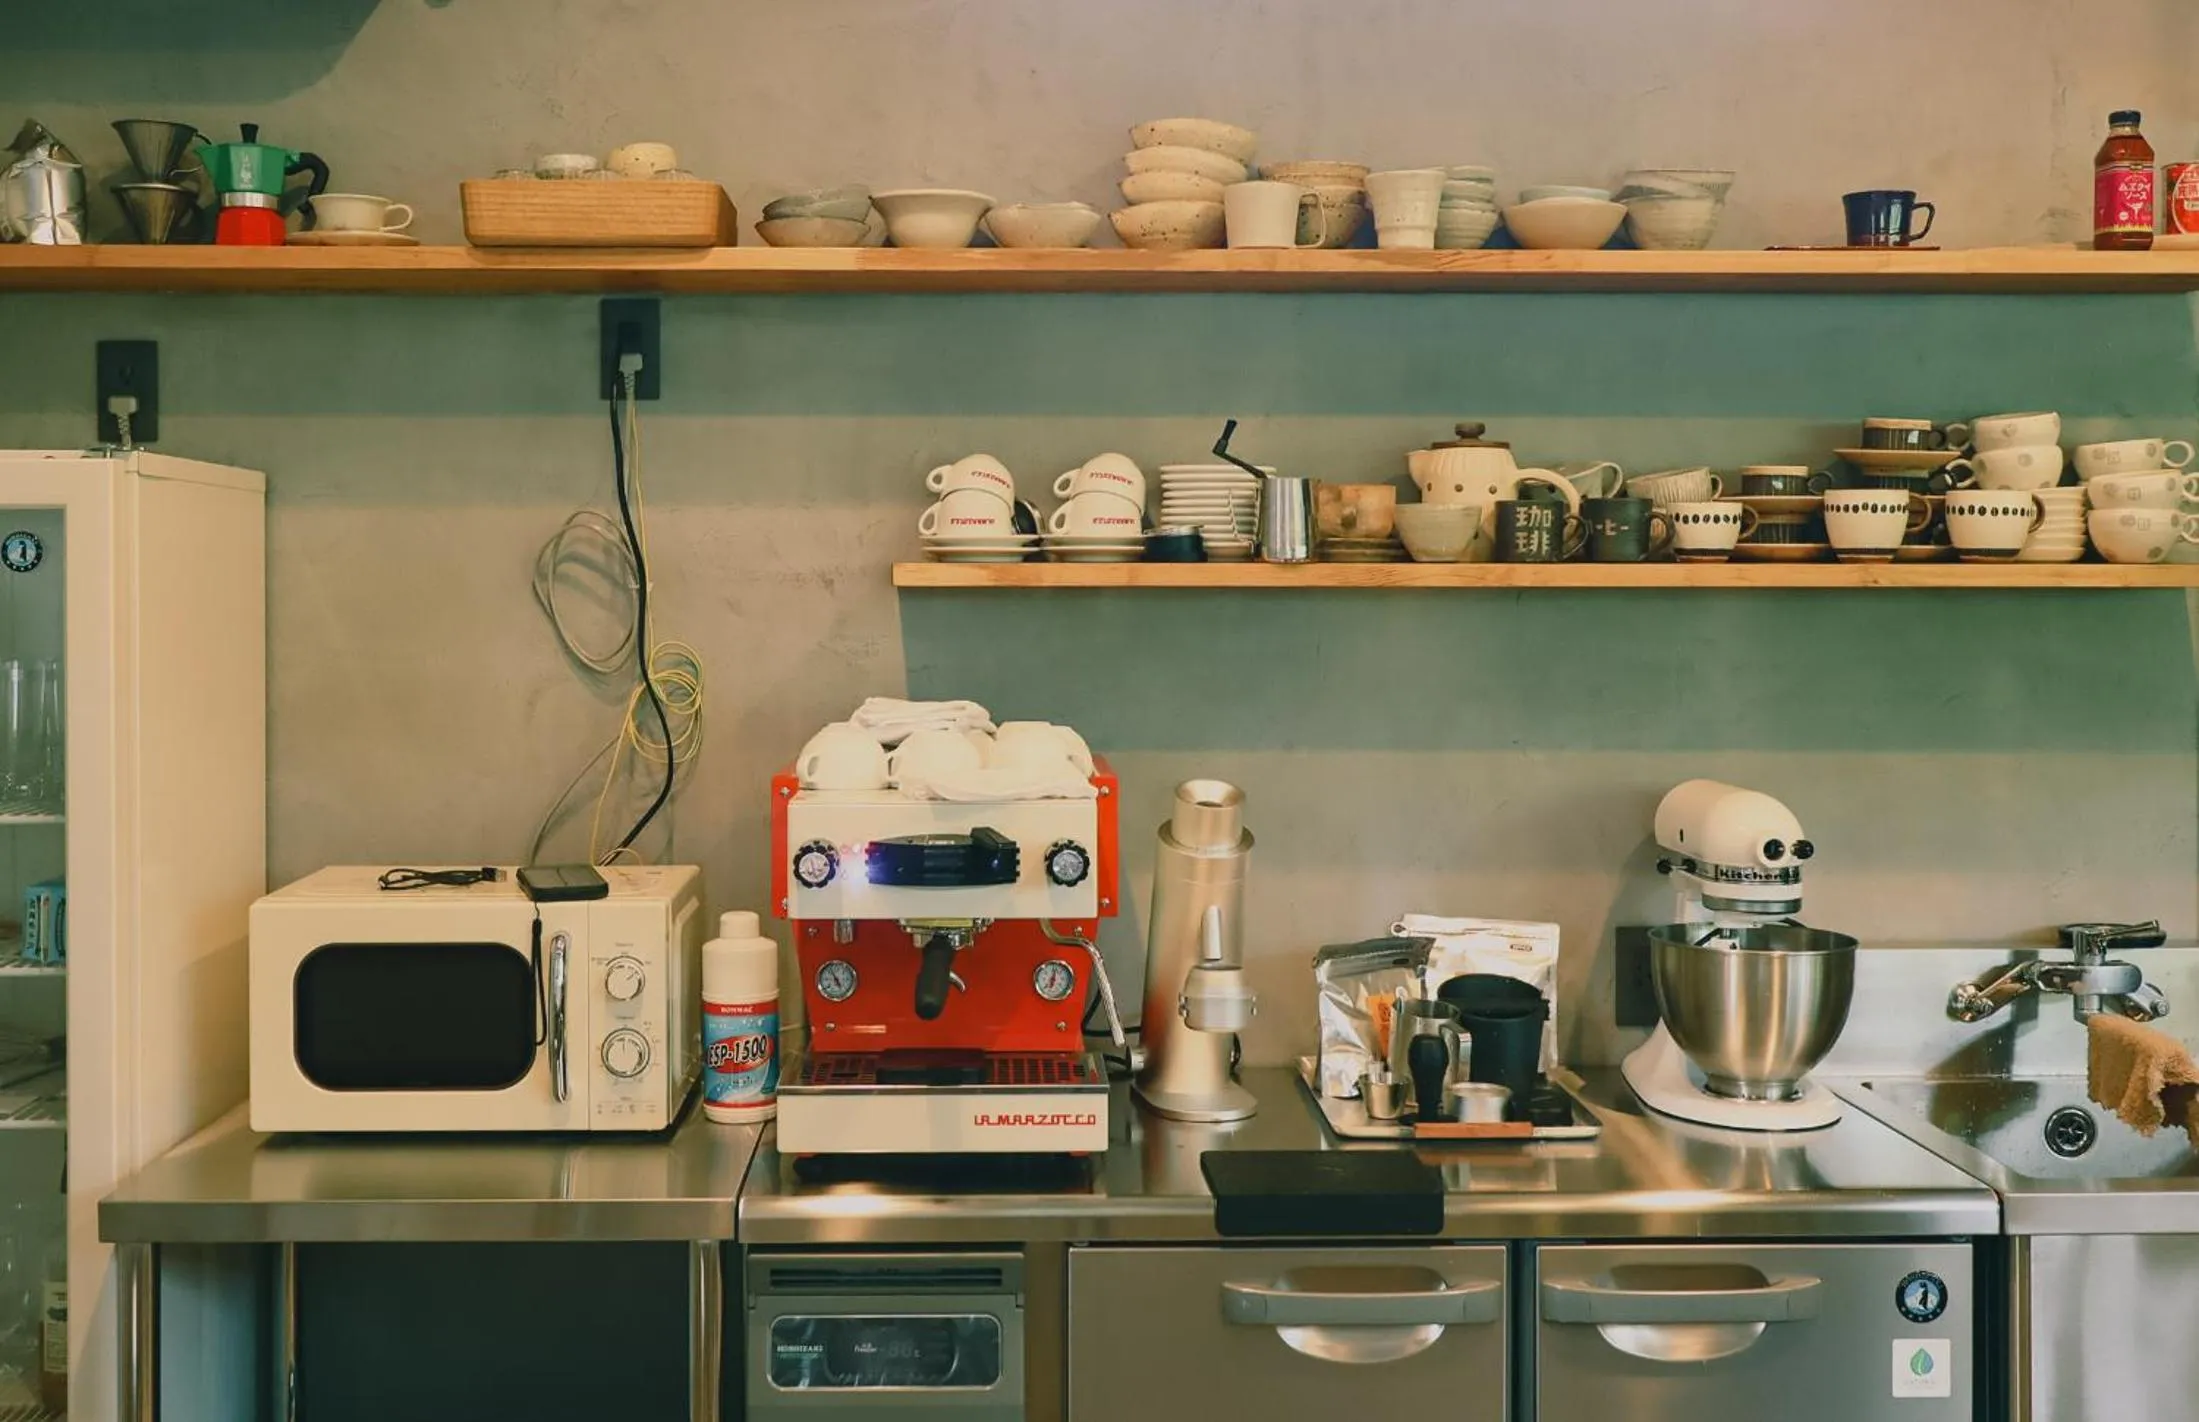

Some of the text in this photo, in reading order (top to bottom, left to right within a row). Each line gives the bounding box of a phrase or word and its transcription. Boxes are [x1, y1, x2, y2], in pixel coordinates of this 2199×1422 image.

[2123, 191, 2148, 200] ソース
[1516, 505, 1551, 554] 珈琲
[1720, 867, 1799, 882] Kitchen
[708, 1034, 767, 1068] ESP-1500
